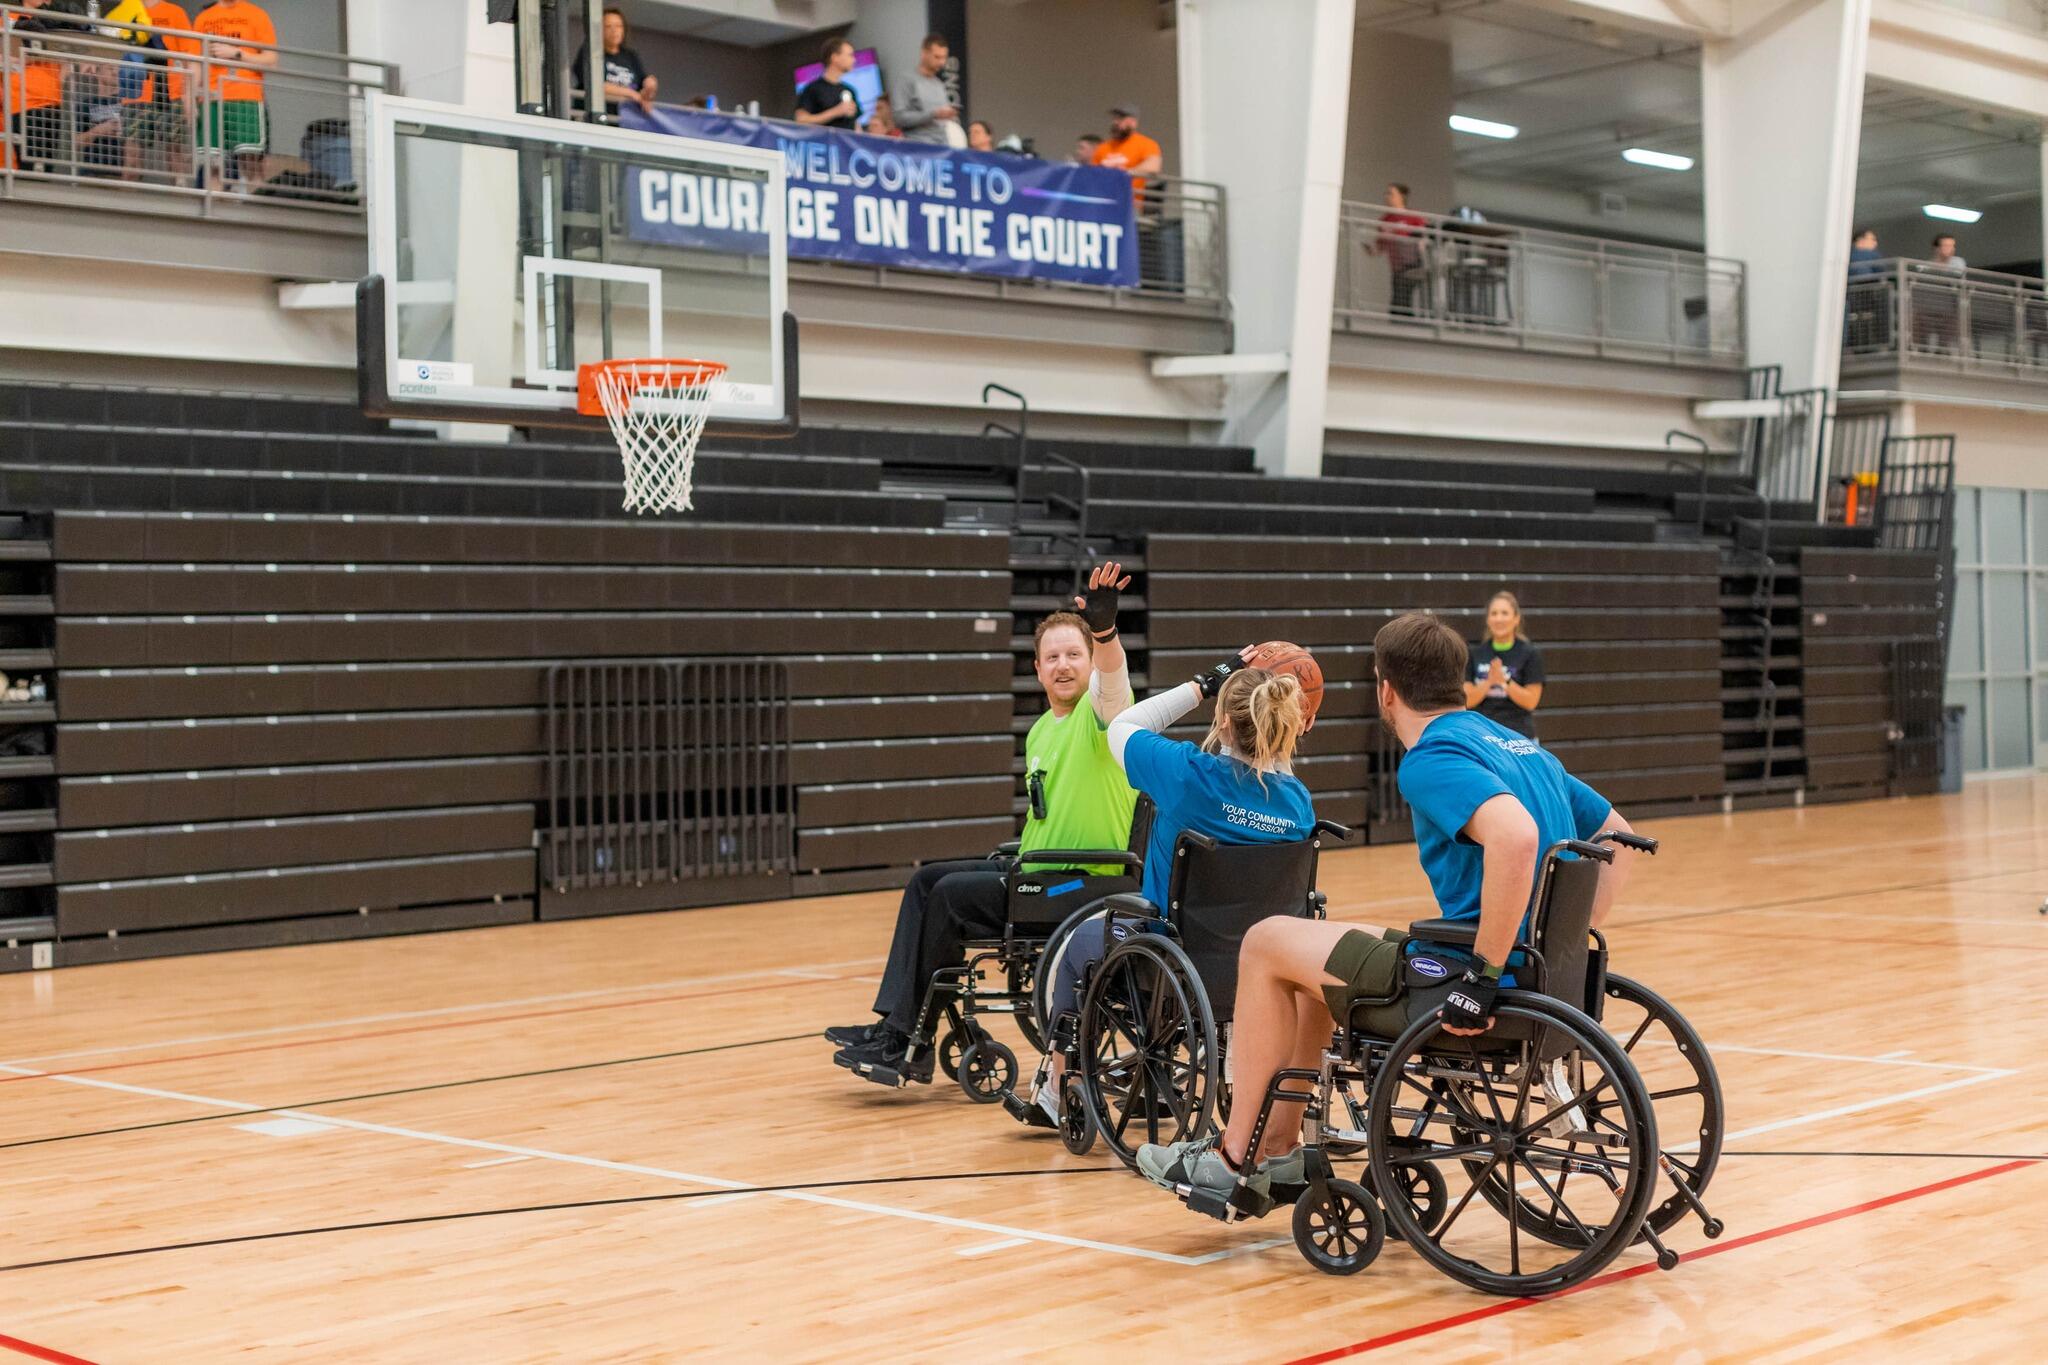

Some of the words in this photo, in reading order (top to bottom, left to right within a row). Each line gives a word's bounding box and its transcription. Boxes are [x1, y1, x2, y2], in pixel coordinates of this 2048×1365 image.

[777, 138, 956, 199] WELCOME
[961, 163, 1013, 205] TO
[853, 195, 909, 249] ON
[920, 203, 996, 258] THE
[1006, 213, 1123, 270] COURT
[1222, 802, 1246, 817] YOUR
[1227, 814, 1247, 826] OUR
[1462, 1000, 1480, 1015] CAN
